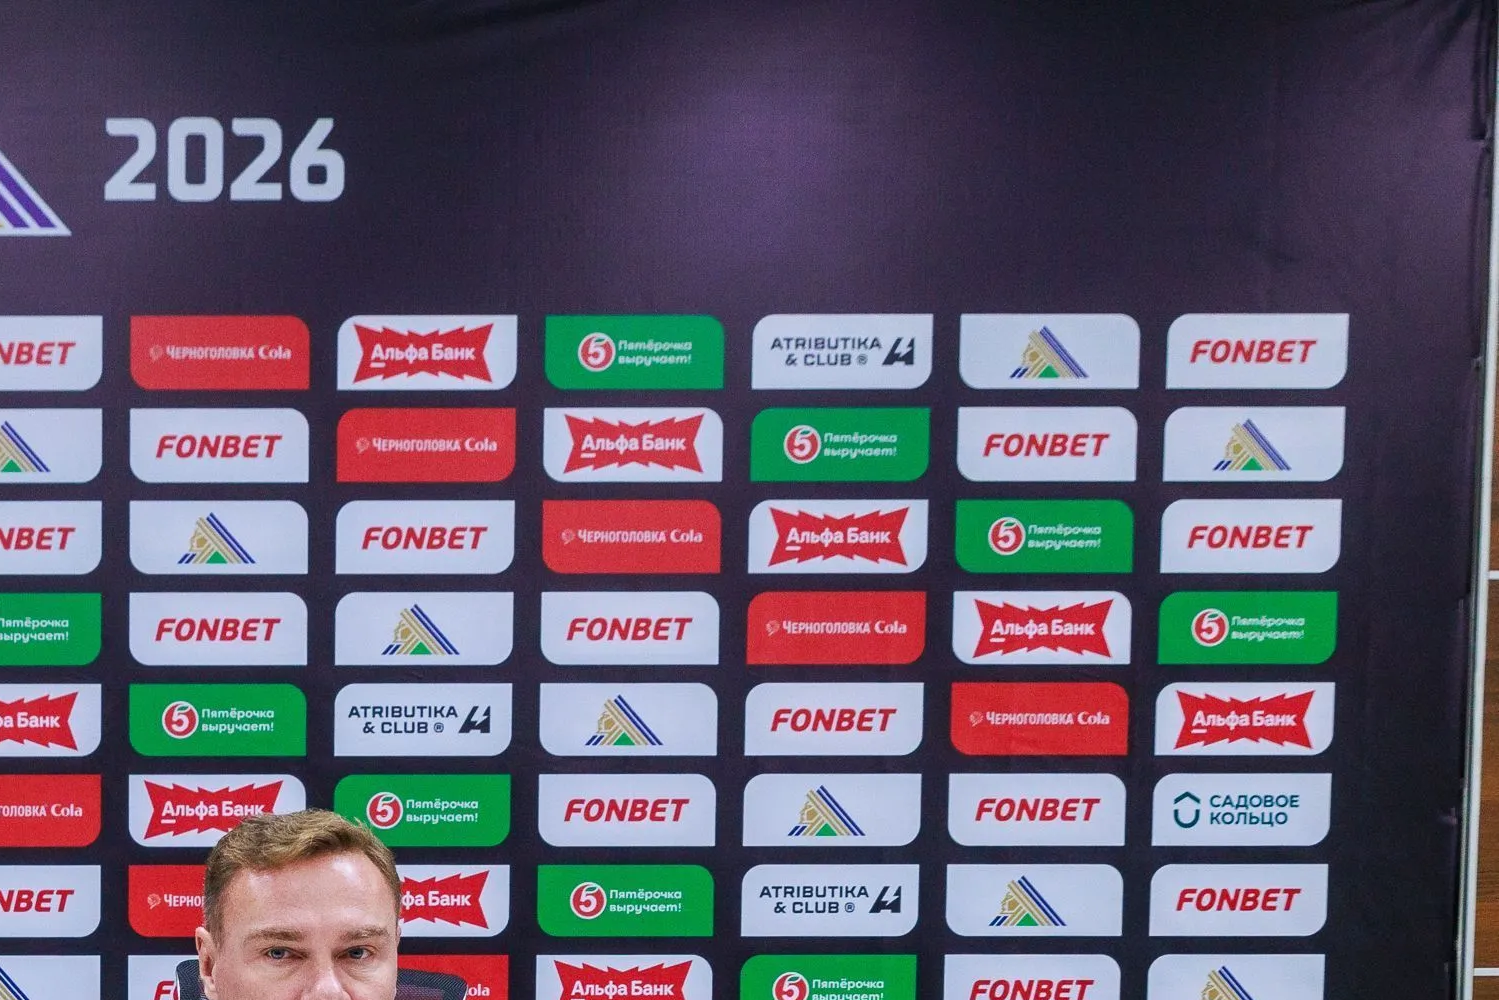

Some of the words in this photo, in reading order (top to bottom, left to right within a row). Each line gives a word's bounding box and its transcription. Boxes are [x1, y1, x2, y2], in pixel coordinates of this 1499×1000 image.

[103, 115, 346, 203] 2026
[771, 338, 881, 349] ATRIBUTIKA
[1191, 340, 1316, 363] FONBET
[371, 343, 428, 366] Альфа
[432, 343, 475, 360] Банк
[804, 354, 851, 366] CLUB
[156, 435, 282, 458] FONBET
[465, 437, 497, 451] Cola
[984, 434, 1109, 457] FONBET
[362, 527, 487, 550] FONBET
[670, 529, 703, 543] Cola
[1188, 526, 1313, 548] FONBET
[156, 618, 281, 641] FONBET
[567, 618, 692, 640] FONBET
[17, 712, 60, 728] Банк
[202, 708, 274, 720] Пятёрочка
[349, 706, 457, 718] ATRIBUTIKA
[202, 722, 273, 734] выручает!
[382, 722, 428, 734] CLUB
[771, 709, 897, 732] FONBET
[976, 798, 1100, 821] FONBET
[1210, 795, 1299, 809] САДОВОЕ
[50, 804, 82, 817] Cola
[161, 801, 218, 822] Альфа
[221, 801, 265, 816] Банк
[565, 799, 689, 822] FONBET
[1210, 812, 1288, 826] КОЛЬЦО
[428, 890, 471, 906] Банк
[610, 889, 682, 901] Пятёрочка
[760, 886, 868, 898] ATRIBUTIKA
[1177, 889, 1301, 911] FONBET
[610, 902, 681, 914] выручает!
[793, 902, 839, 913] CLUB
[468, 984, 491, 997] ola
[631, 982, 673, 998] Банк
